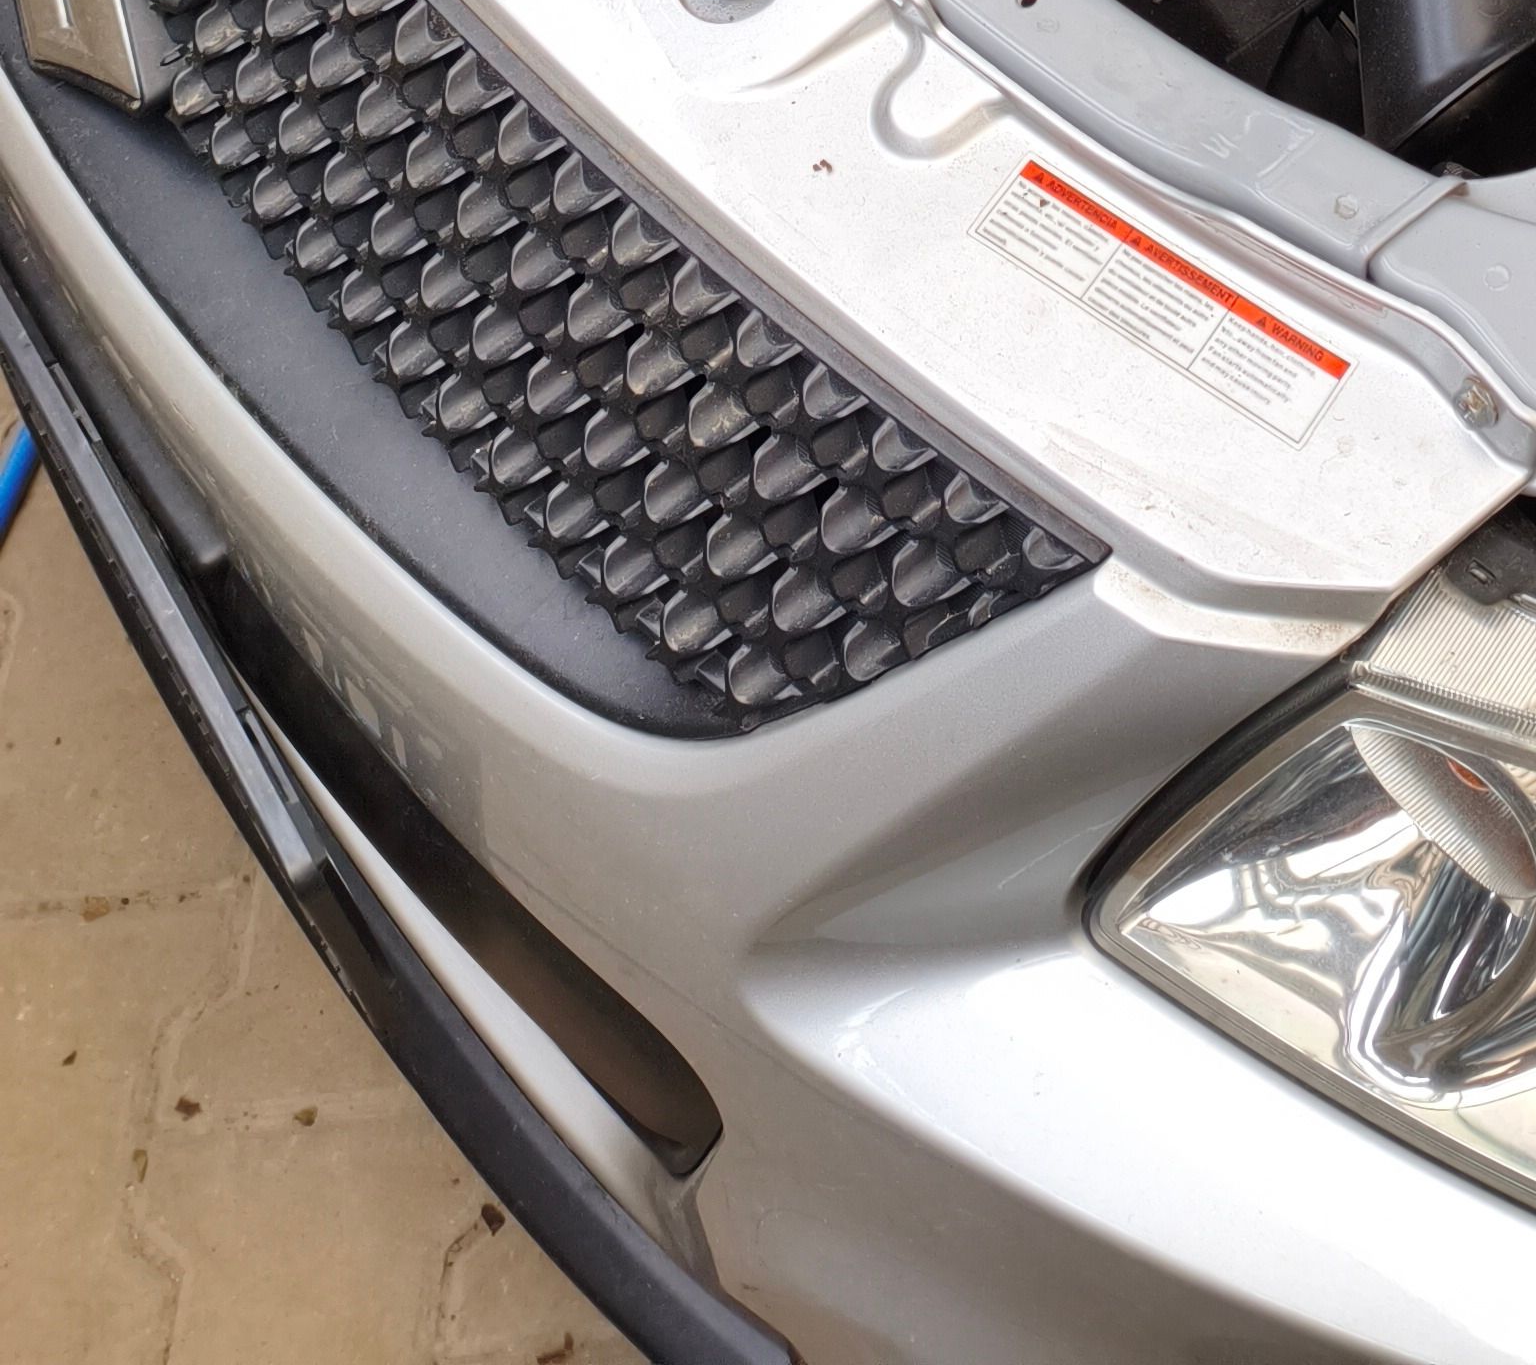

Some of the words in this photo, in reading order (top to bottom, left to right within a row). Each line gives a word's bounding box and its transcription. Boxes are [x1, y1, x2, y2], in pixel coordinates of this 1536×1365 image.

[1046, 178, 1119, 231] ADVERTENCIA
[1144, 243, 1234, 304] AVERTISSEMENT
[1270, 322, 1326, 362] WARNING
